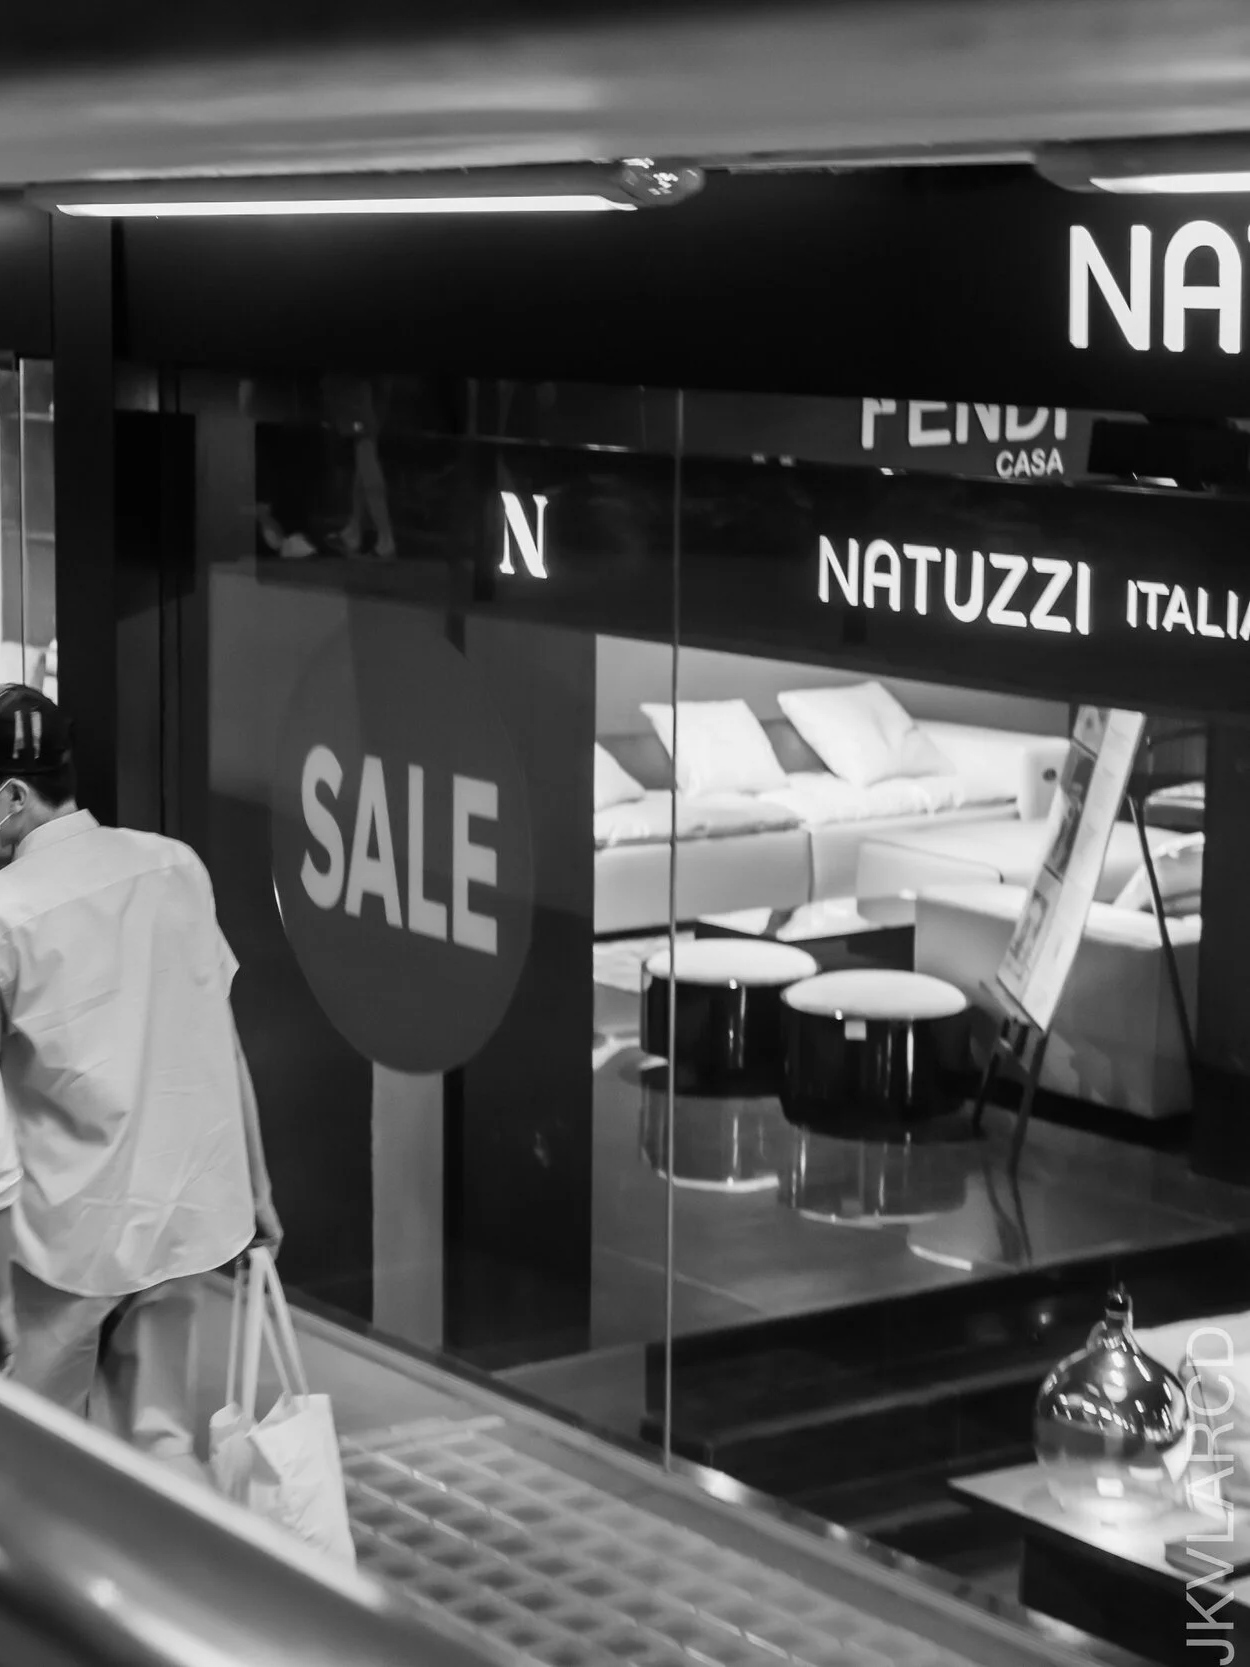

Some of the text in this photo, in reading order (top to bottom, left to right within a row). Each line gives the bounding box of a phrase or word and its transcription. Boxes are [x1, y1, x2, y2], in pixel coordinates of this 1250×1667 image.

[1069, 219, 1250, 354] NA
[996, 447, 1064, 479] CASA
[499, 490, 549, 579] N
[818, 534, 1093, 636] NATUZZI
[300, 744, 498, 957] SALE
